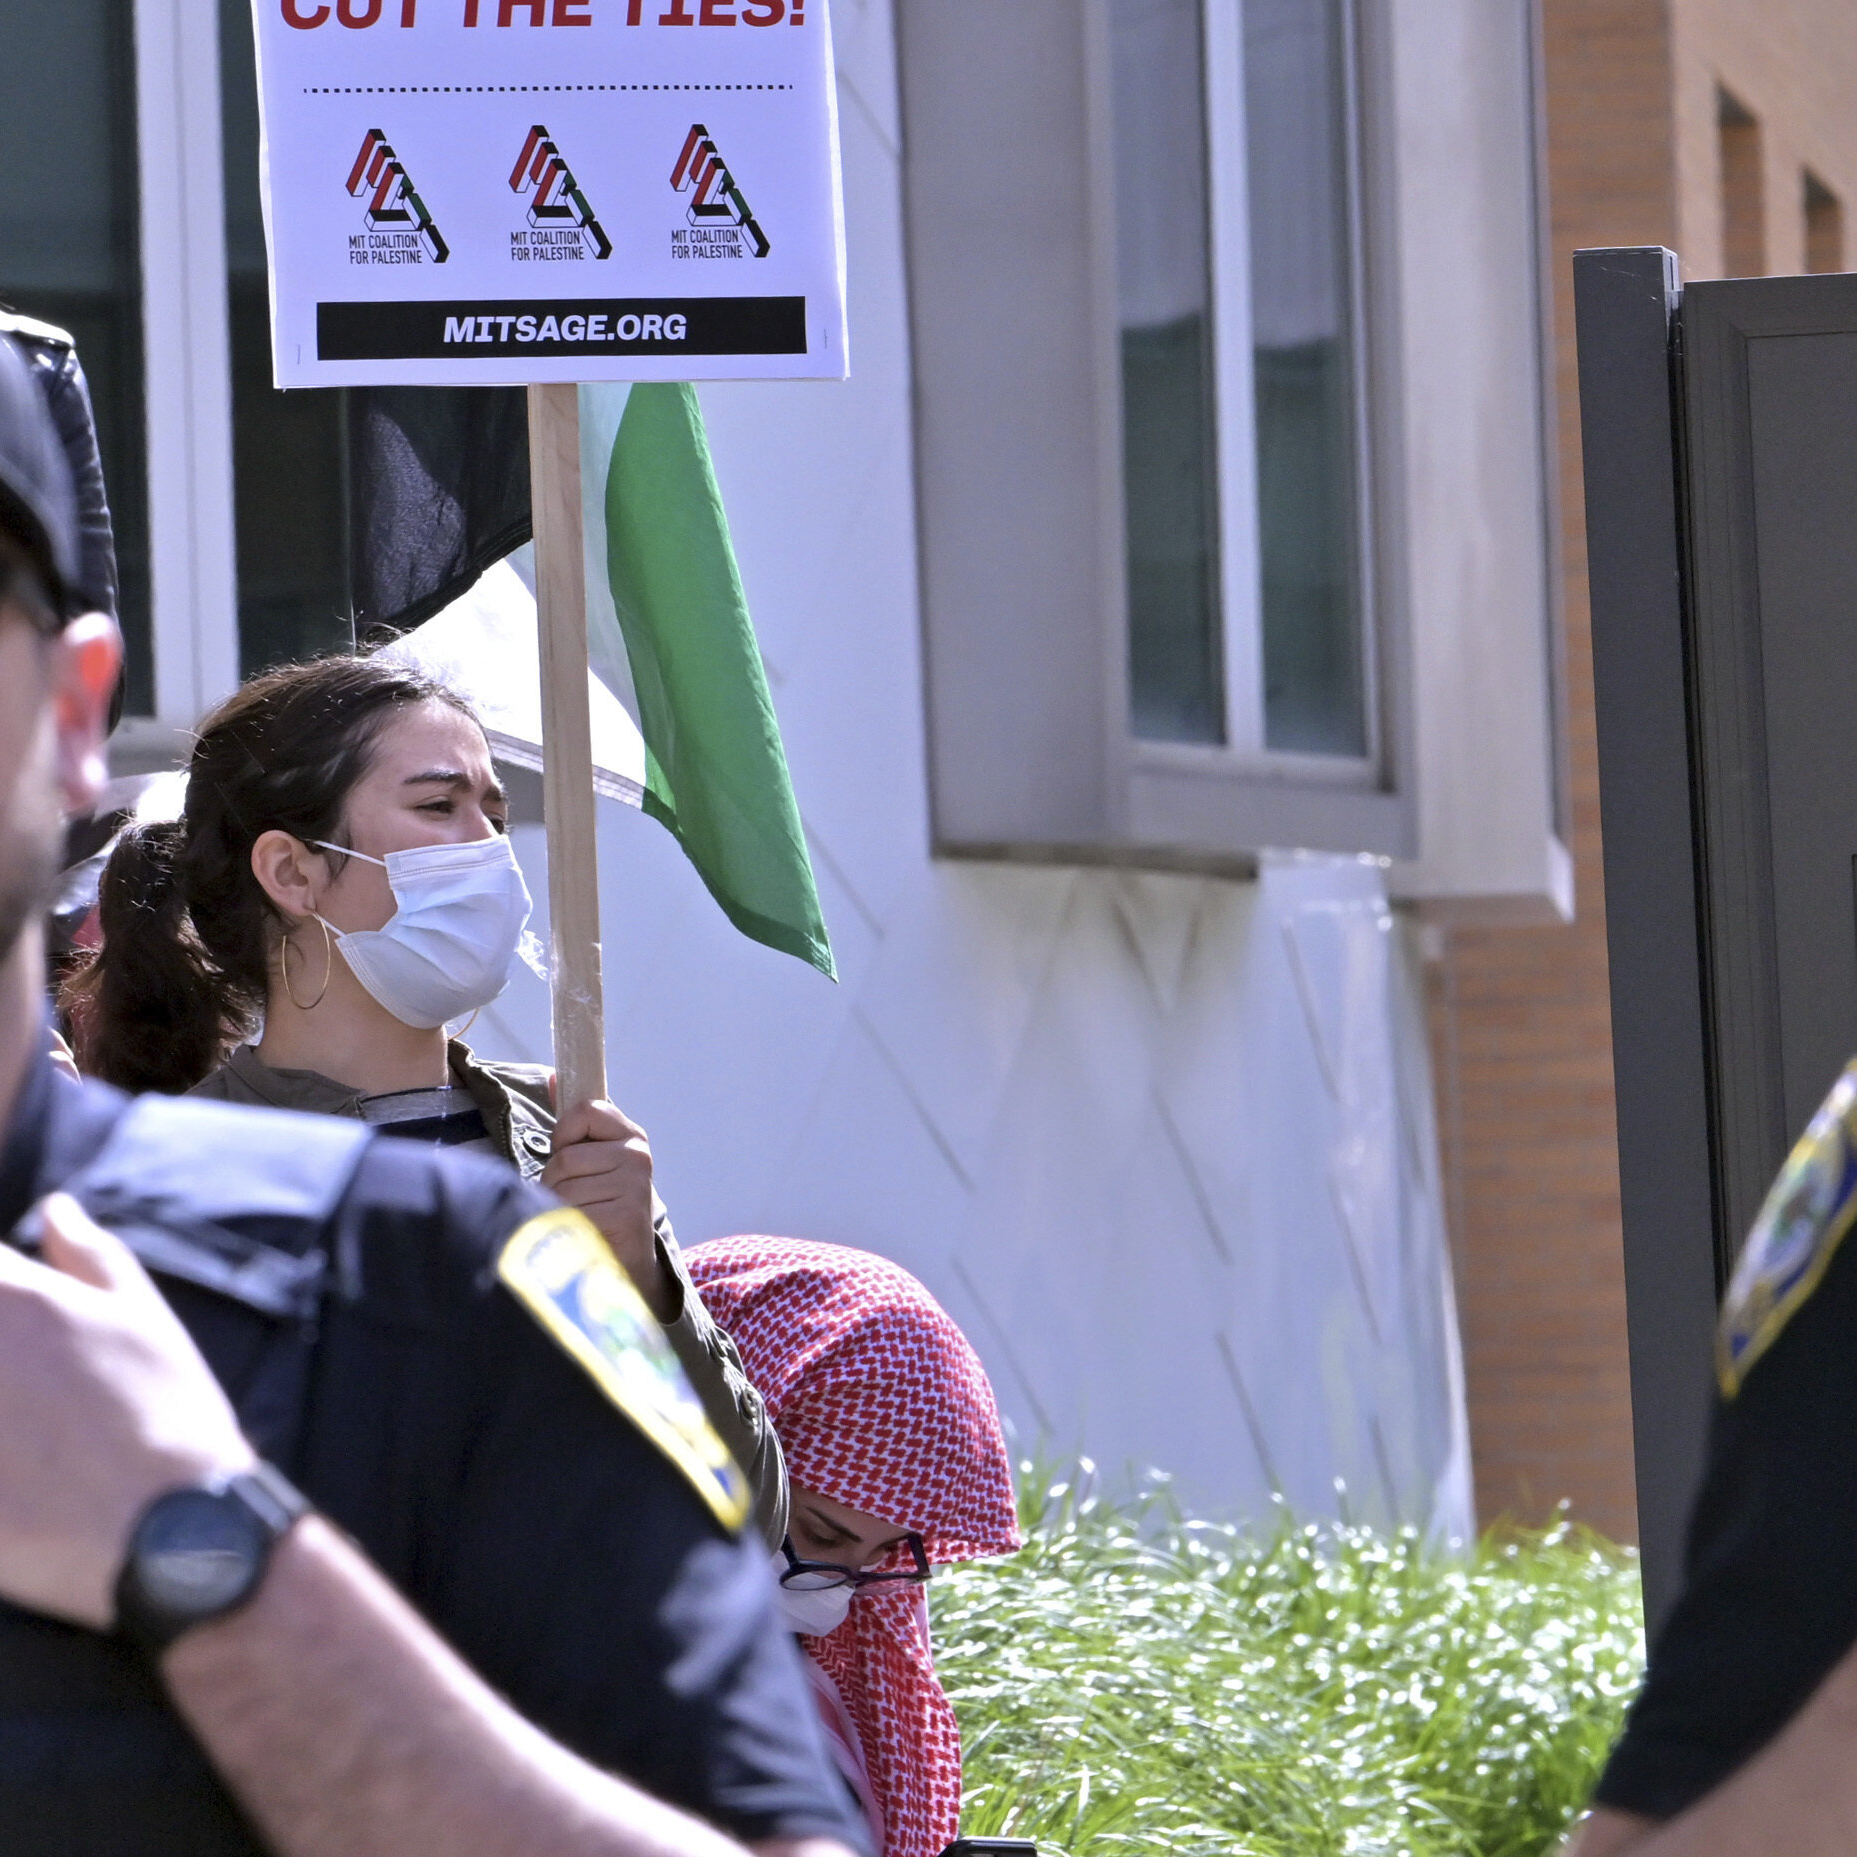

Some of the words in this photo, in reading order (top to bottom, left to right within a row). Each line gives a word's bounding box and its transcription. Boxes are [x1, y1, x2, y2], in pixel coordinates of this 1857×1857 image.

[349, 235, 366, 249] MIT
[369, 234, 419, 248] COALITION
[510, 231, 527, 246] MIT
[530, 230, 581, 245] COALITION
[671, 229, 687, 243] MIT
[690, 229, 739, 243] COALITION
[350, 250, 369, 264] FOR
[372, 250, 422, 264] PALESTINE
[511, 247, 530, 261] FOR
[533, 246, 585, 260] PALESTINE
[672, 245, 690, 259] FOR
[692, 244, 743, 259] PALESTINE
[443, 313, 687, 343] MITSAGE.ORG
